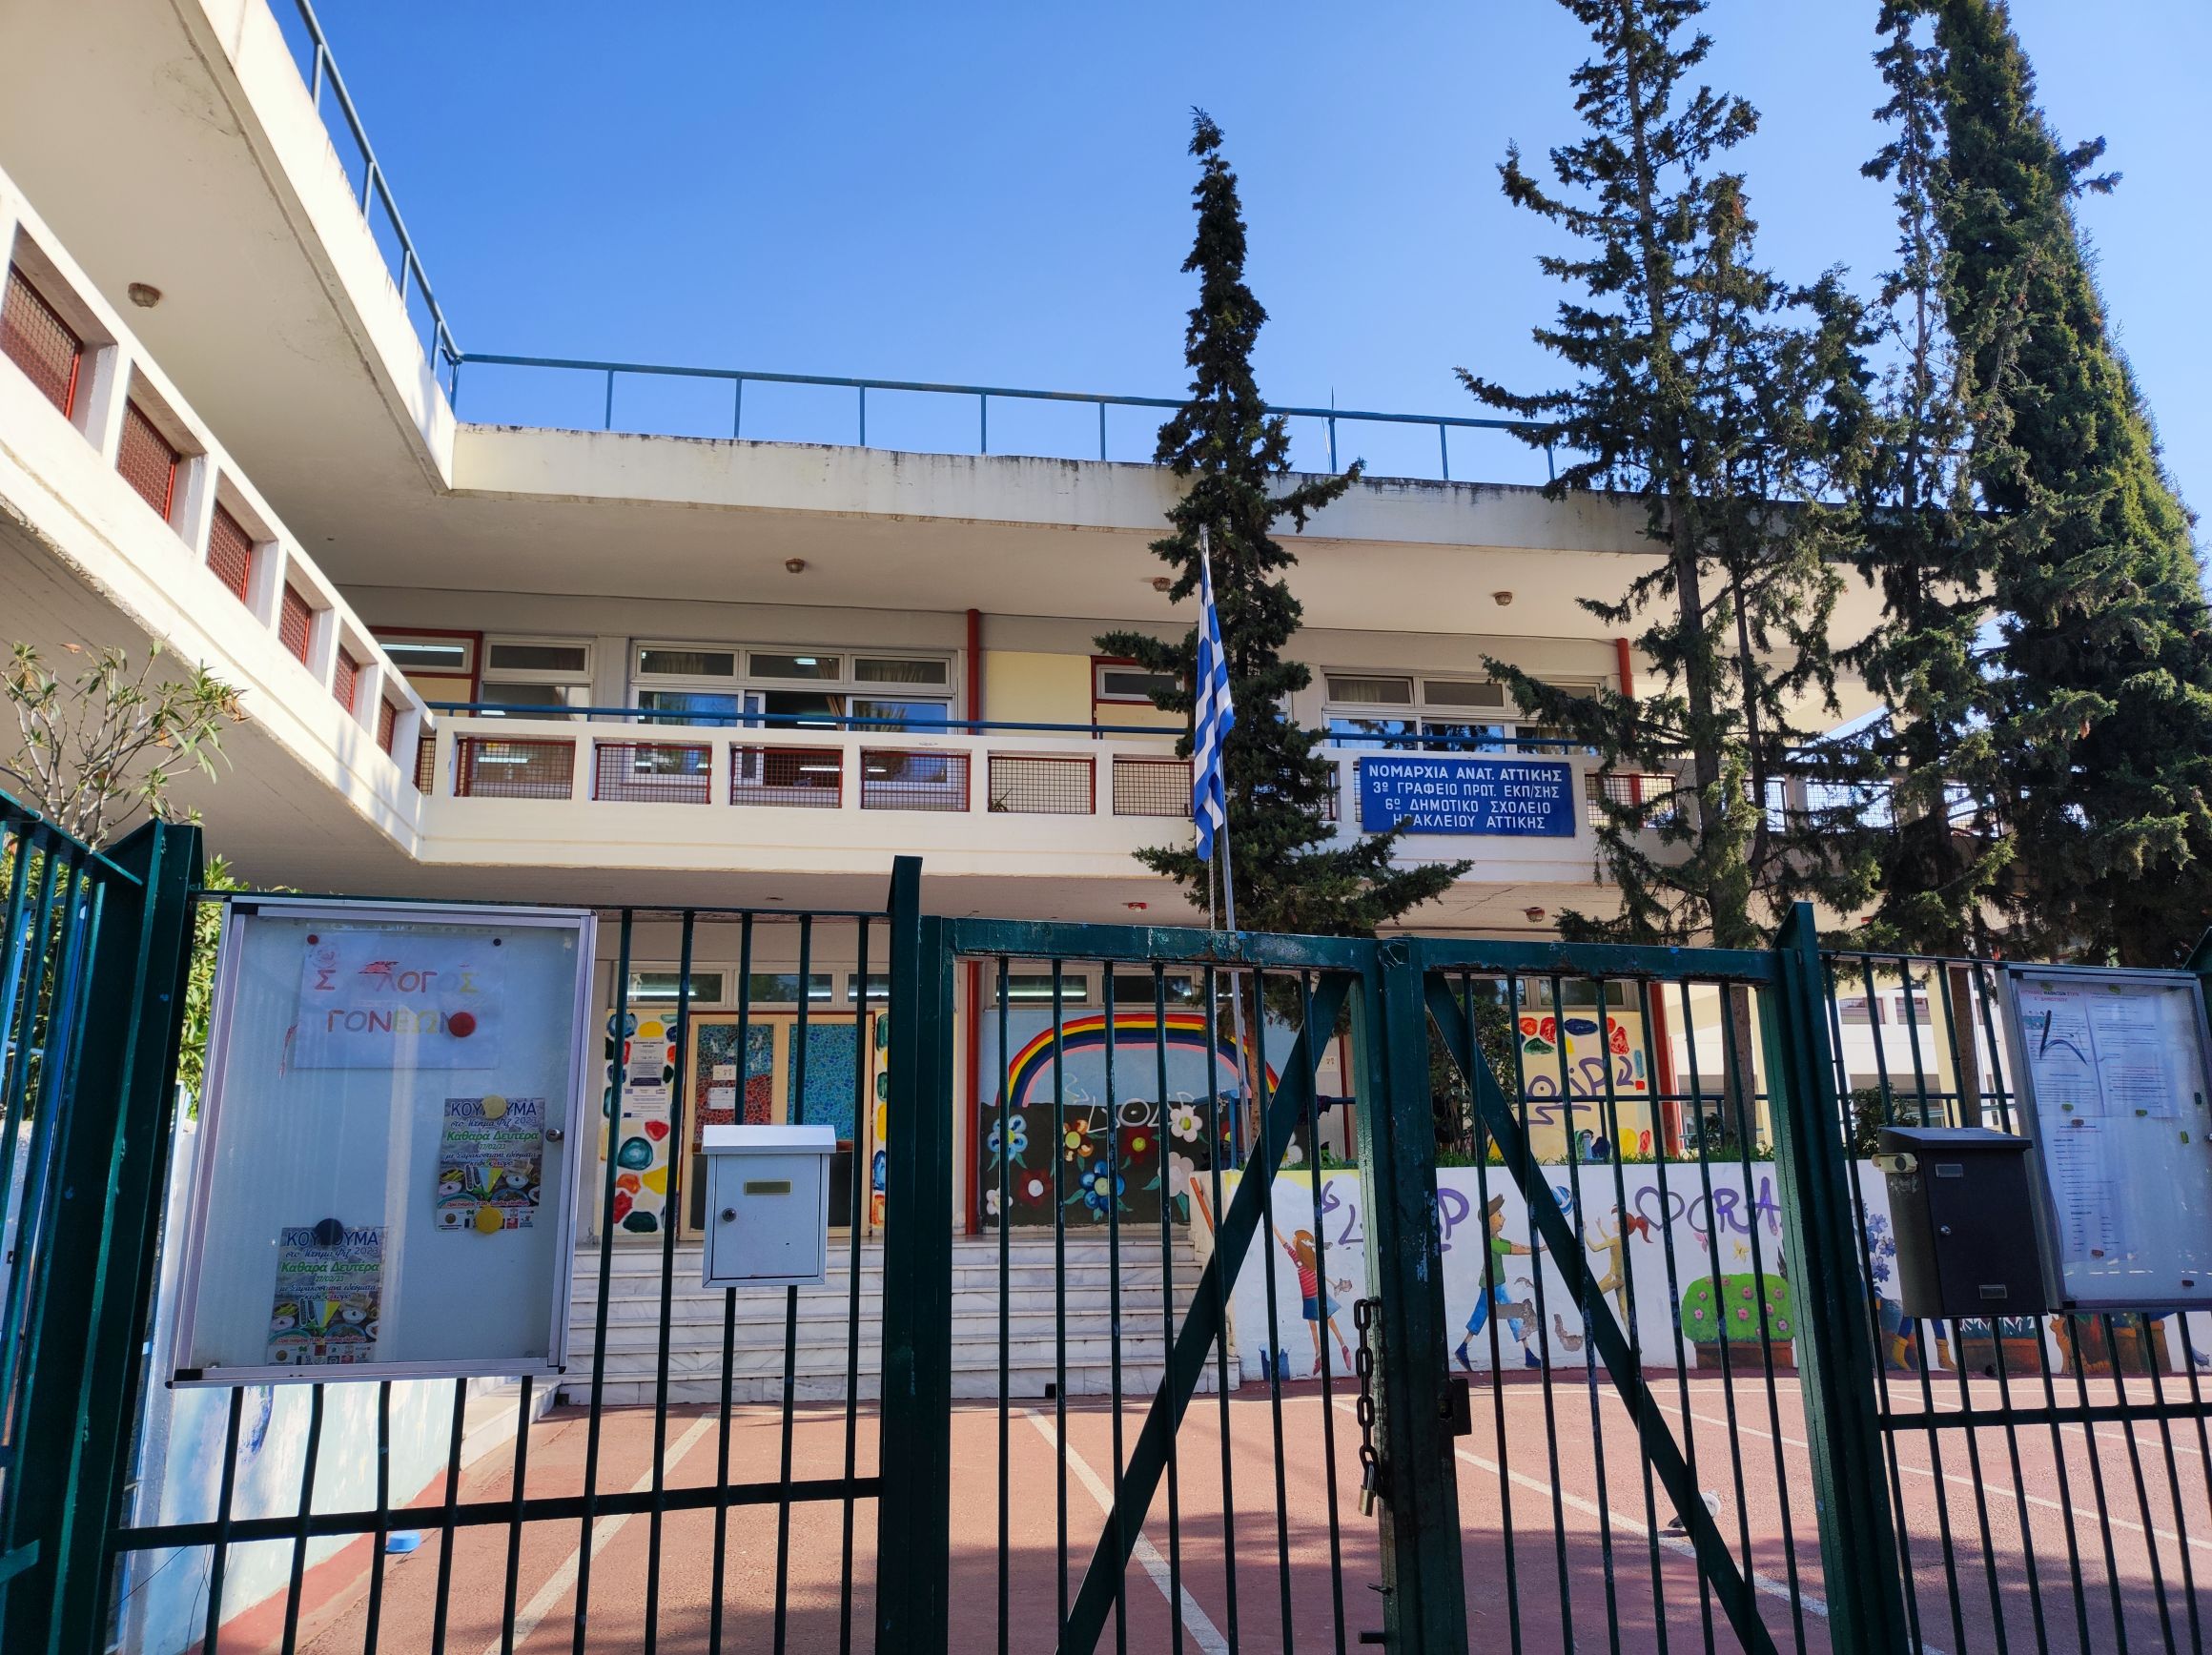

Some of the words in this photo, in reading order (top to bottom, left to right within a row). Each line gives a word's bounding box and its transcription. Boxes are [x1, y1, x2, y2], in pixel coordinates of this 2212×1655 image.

[1368, 765, 1448, 779] ΝΟΜΑΡΧΙΑ
[1456, 766, 1495, 781] ΑΝΑΤ.
[1500, 768, 1563, 782] ΑΤΤΙΚΗΣ
[1397, 782, 1458, 796] ΓΡΑΦΕΙΟ
[1464, 784, 1497, 797] ΠΡΩΤ.
[1504, 785, 1560, 799] ΕΚΠ/ΣΗΣ
[1409, 799, 1479, 812] ΔΗΜΟΤΙΚΟ
[1490, 801, 1551, 814] ΣΧΟΛΕΙΟ
[1393, 813, 1476, 828] ΗΑΚΛΕΙΟΥ
[1486, 815, 1546, 829] ΑΤΤΙΚΗΣ
[451, 1102, 537, 1116] ΚΟΥΥΜΑ
[446, 1131, 490, 1142] Καθαρά
[493, 1130, 539, 1142] Δευτέρα
[287, 1231, 379, 1246] ΚΟΥΥΜΑ
[281, 1261, 328, 1274] Καθαρά
[330, 1261, 379, 1274] Δευτέρα
